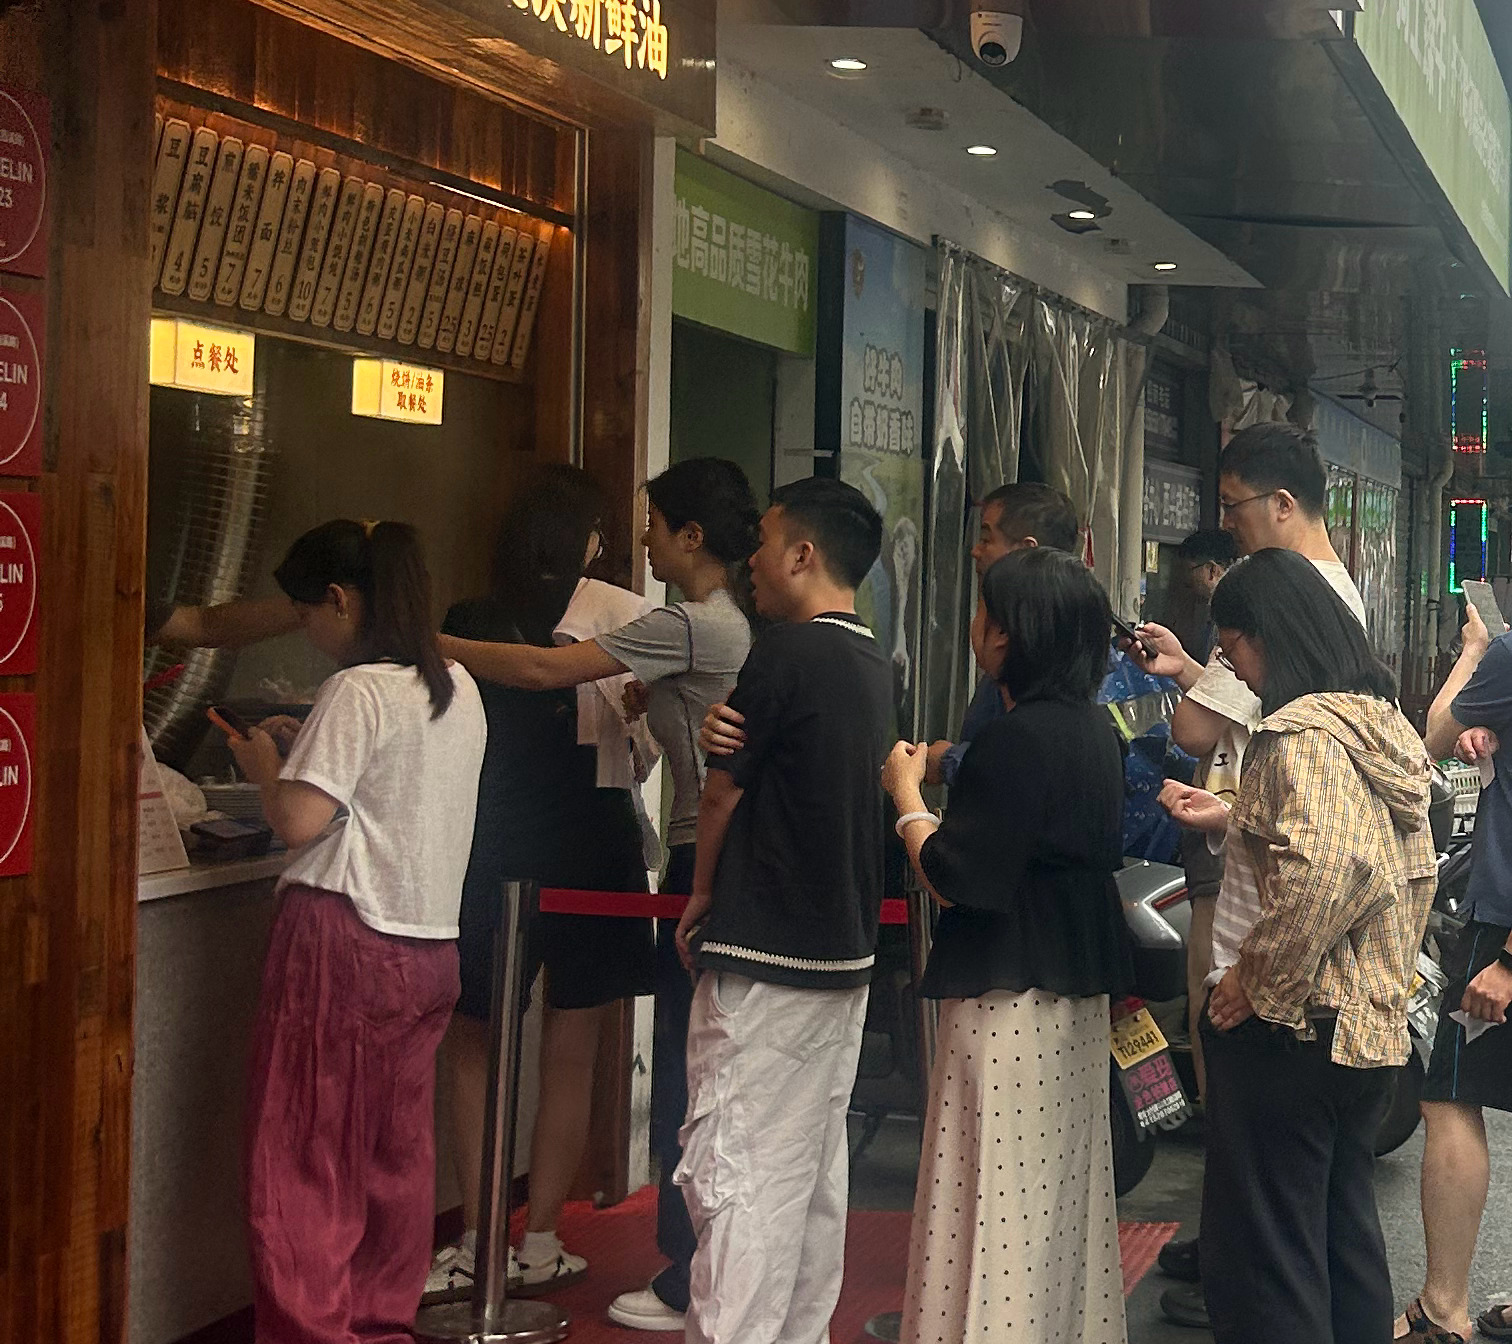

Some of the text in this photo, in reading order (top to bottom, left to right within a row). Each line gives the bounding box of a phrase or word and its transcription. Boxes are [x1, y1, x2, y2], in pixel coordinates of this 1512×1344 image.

[191, 340, 239, 374] 点餐处
[391, 368, 434, 393] 烧饼/油条
[396, 391, 427, 413] 取餐处
